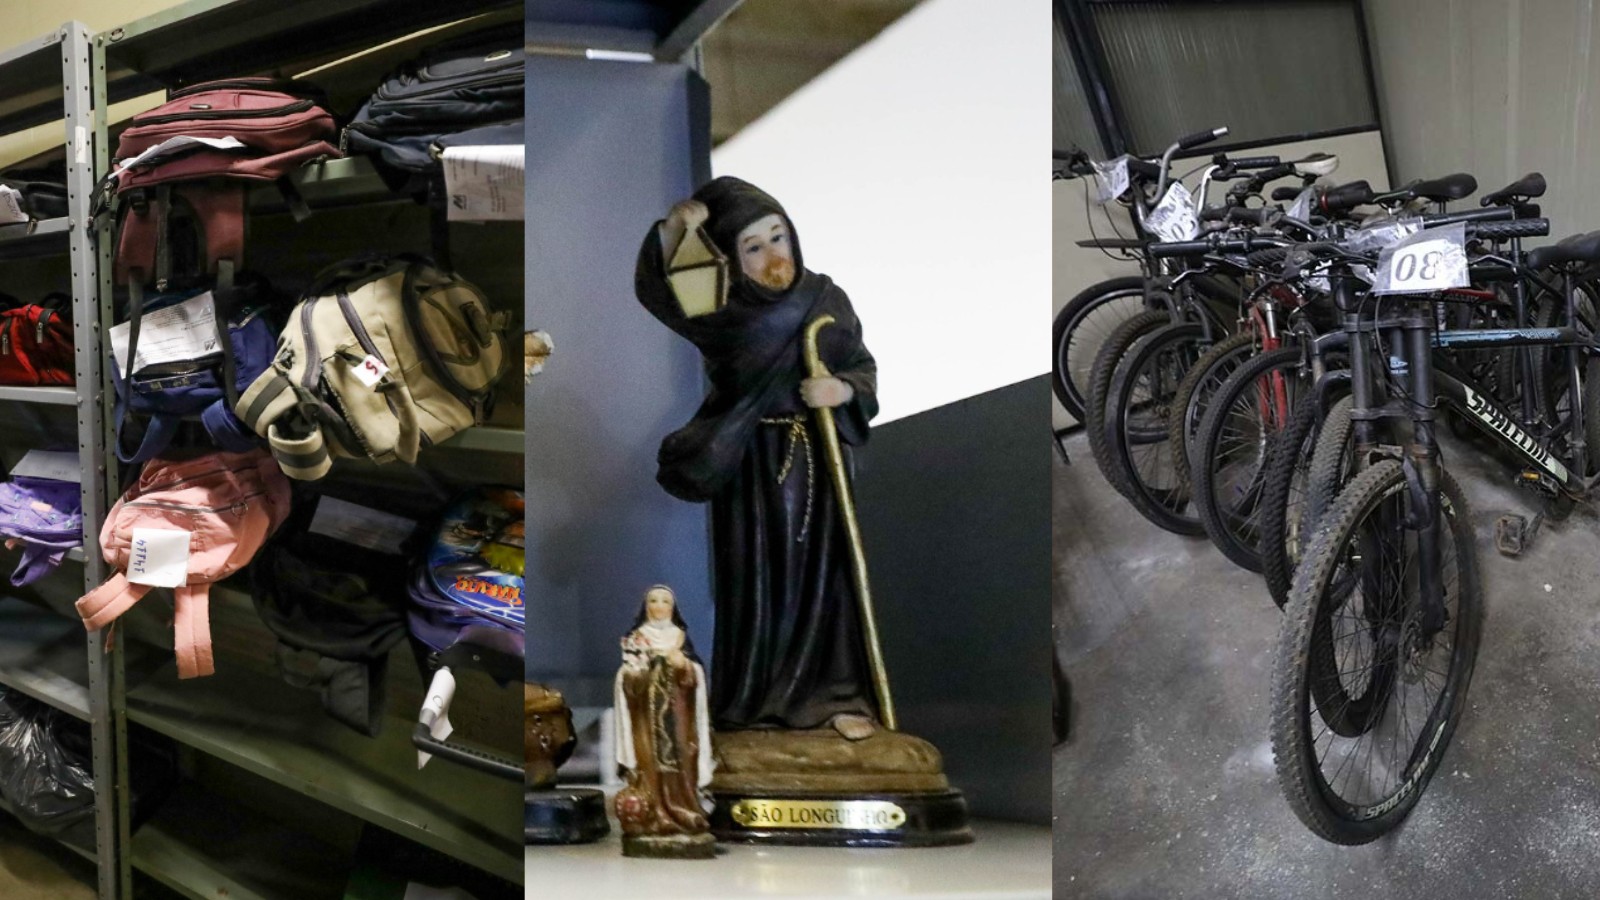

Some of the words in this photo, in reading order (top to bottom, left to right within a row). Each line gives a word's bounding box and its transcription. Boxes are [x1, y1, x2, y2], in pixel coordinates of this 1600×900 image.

[1395, 250, 1444, 281] 08
[455, 577, 522, 605] NARUTO
[751, 804, 782, 822] SÃO
[789, 807, 888, 824] LONGUIHO
